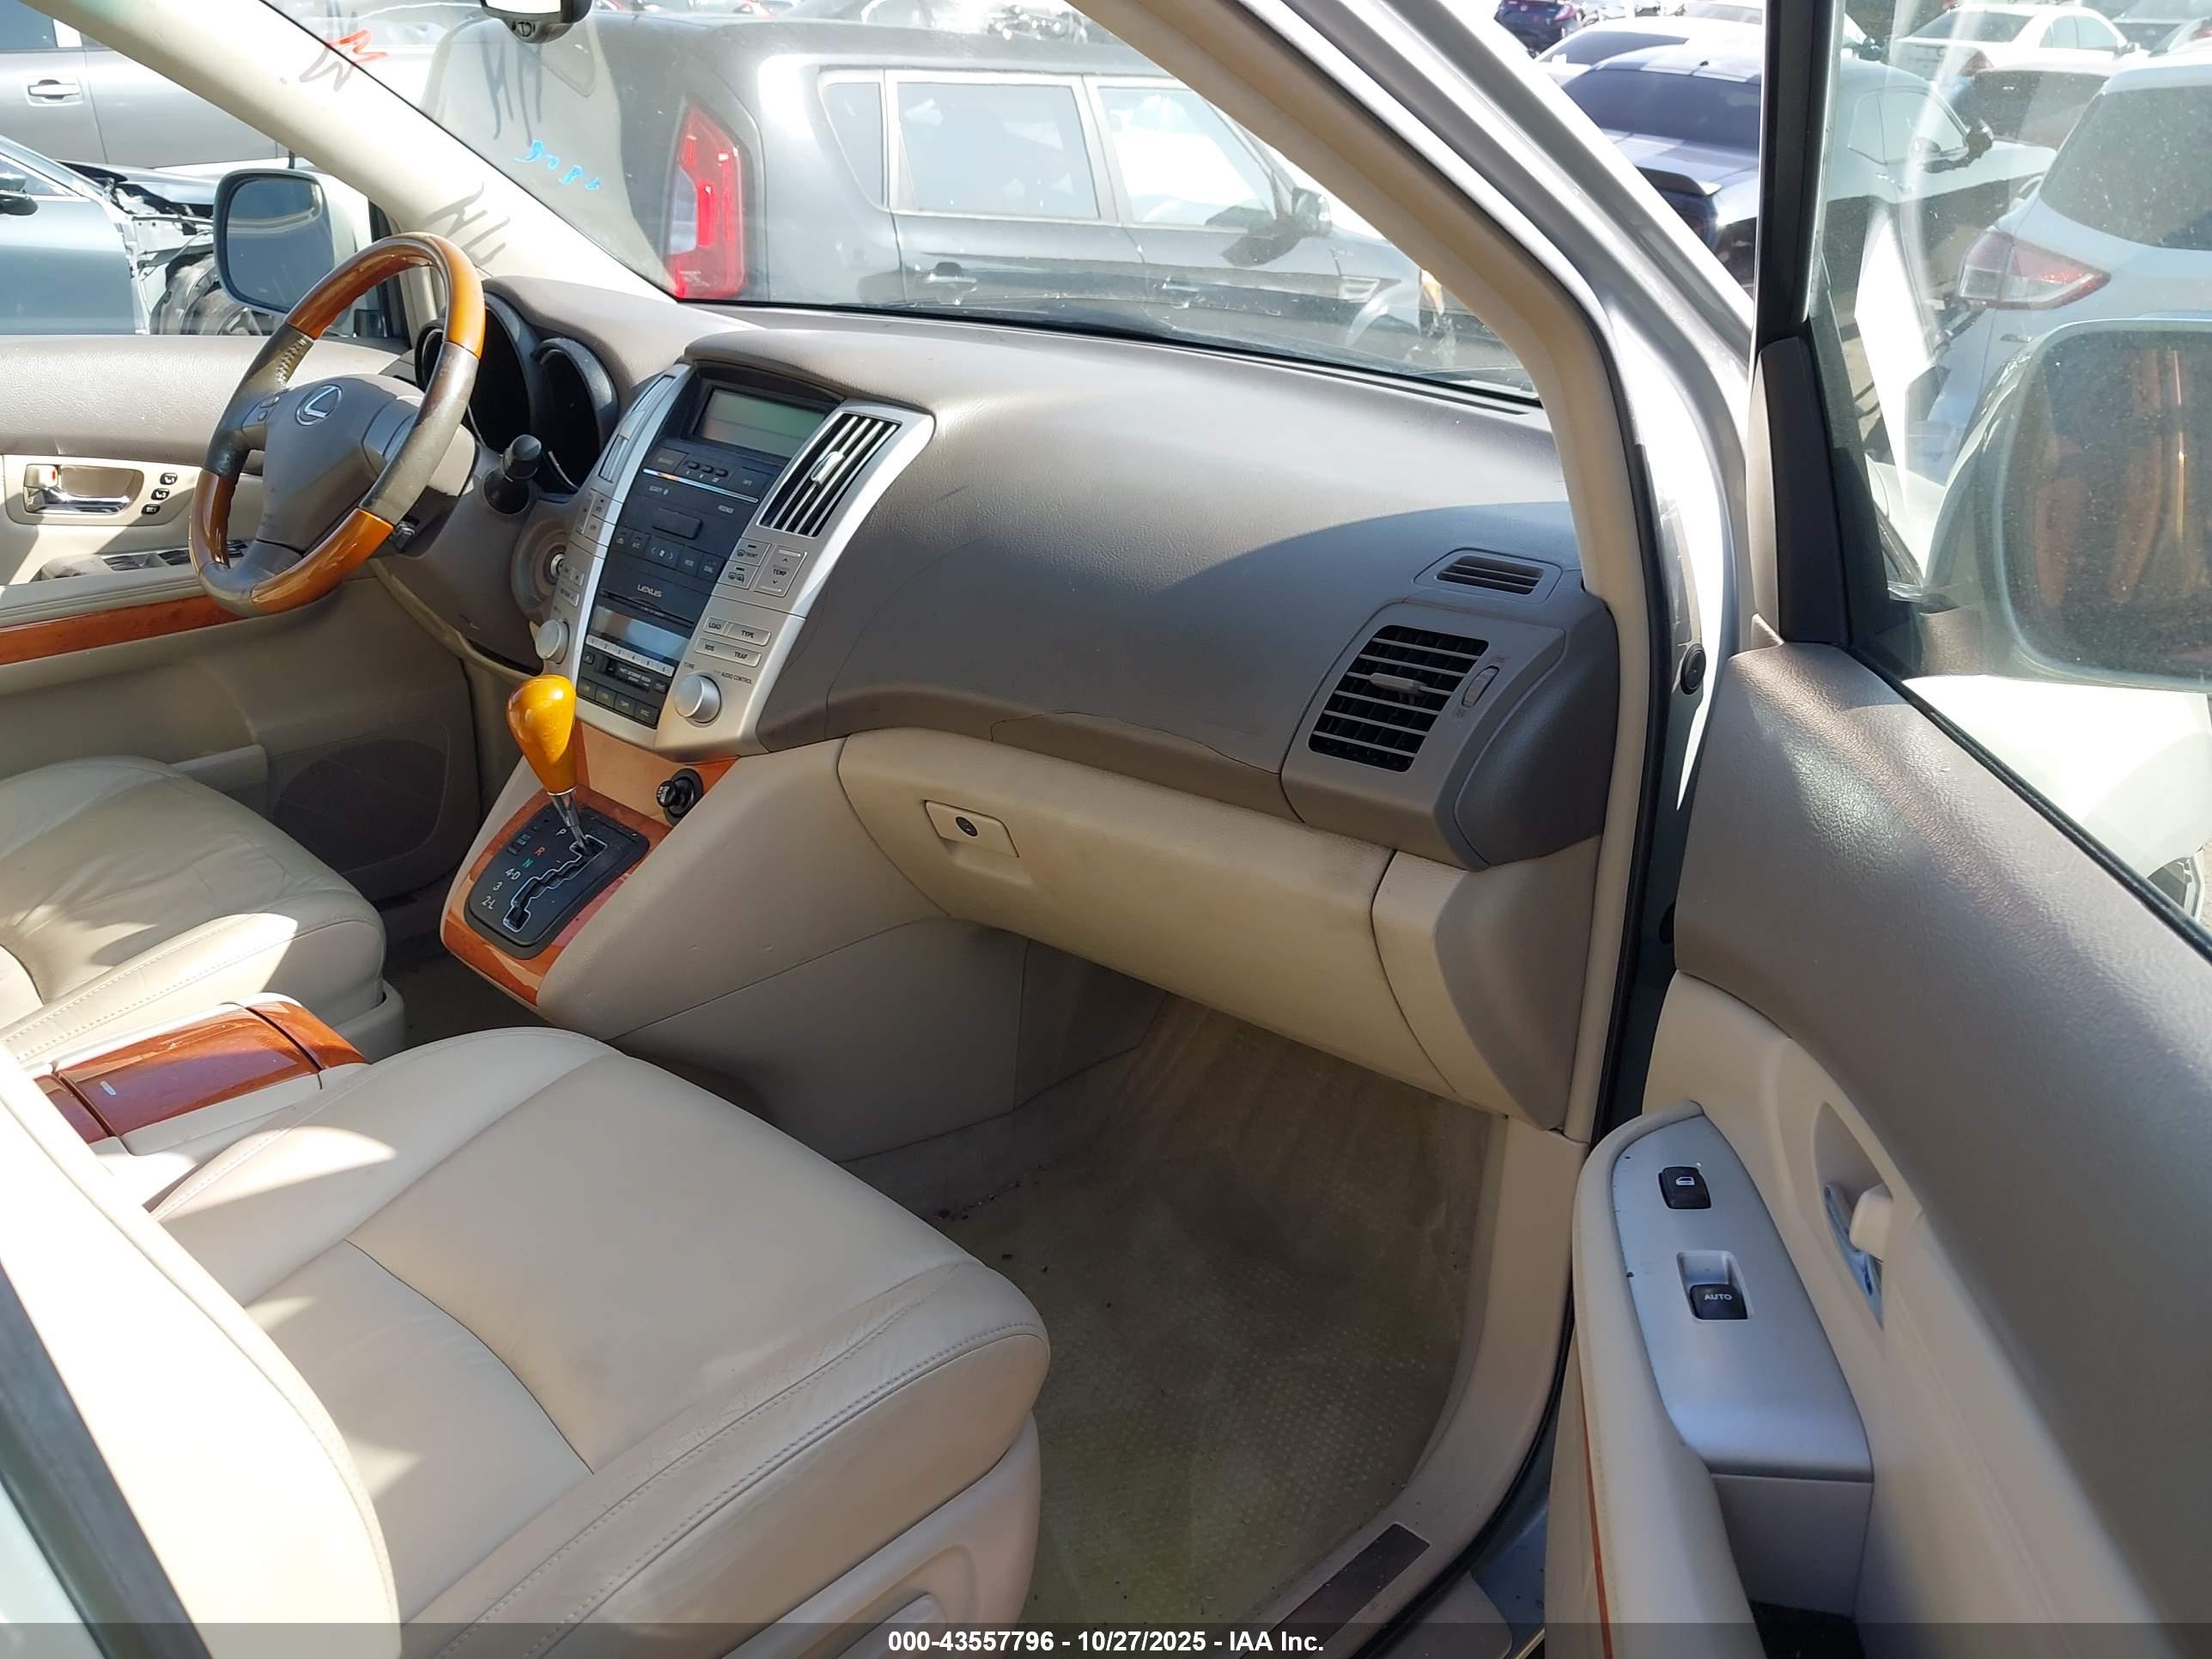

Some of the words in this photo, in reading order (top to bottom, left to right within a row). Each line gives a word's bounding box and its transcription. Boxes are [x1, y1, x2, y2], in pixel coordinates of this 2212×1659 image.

[637, 584, 663, 598] LEXUS
[734, 675, 752, 684] CONTROL
[535, 847, 545, 855] R
[522, 859, 532, 867] N
[493, 881, 503, 890] 3
